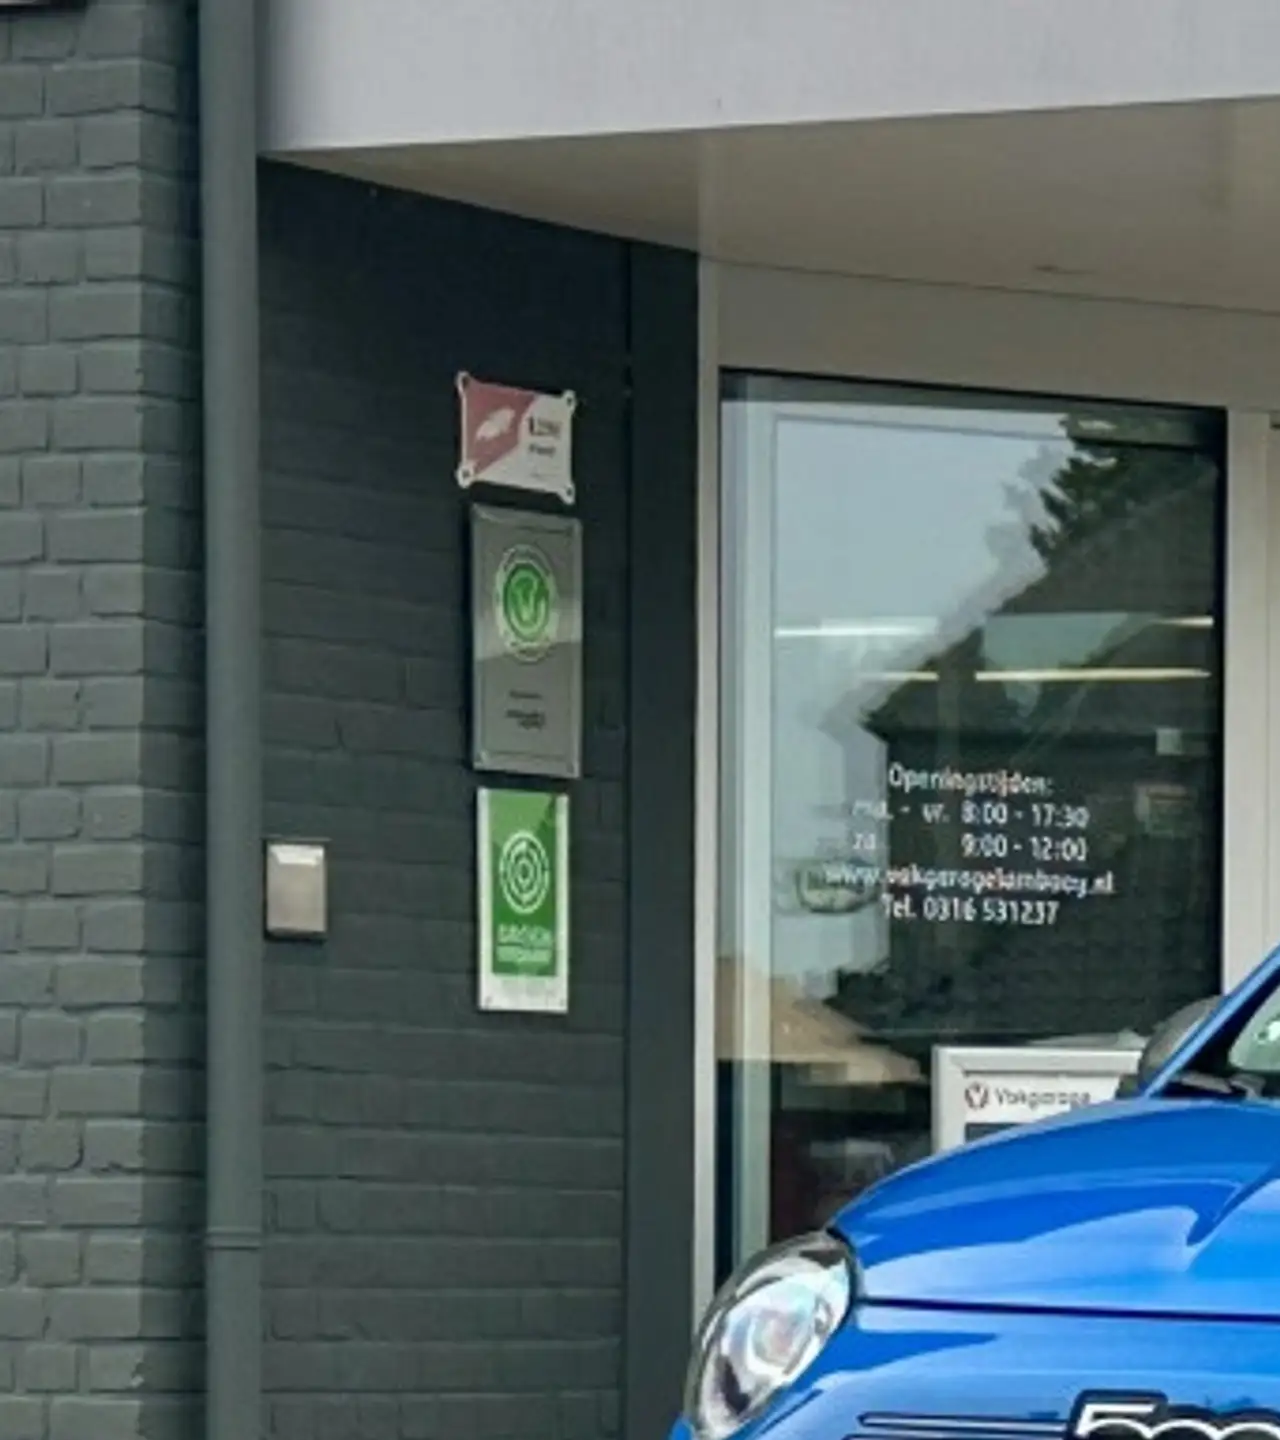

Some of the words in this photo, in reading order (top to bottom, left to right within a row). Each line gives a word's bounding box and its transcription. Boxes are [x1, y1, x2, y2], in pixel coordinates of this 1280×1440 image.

[962, 800, 1008, 825] 8:00
[1031, 803, 1091, 829] 17:30
[961, 833, 1008, 858] 9:00
[1030, 837, 1088, 862] 12:00
[881, 893, 918, 919] Tel.
[923, 897, 976, 923] 0316
[981, 899, 1061, 926] 531237
